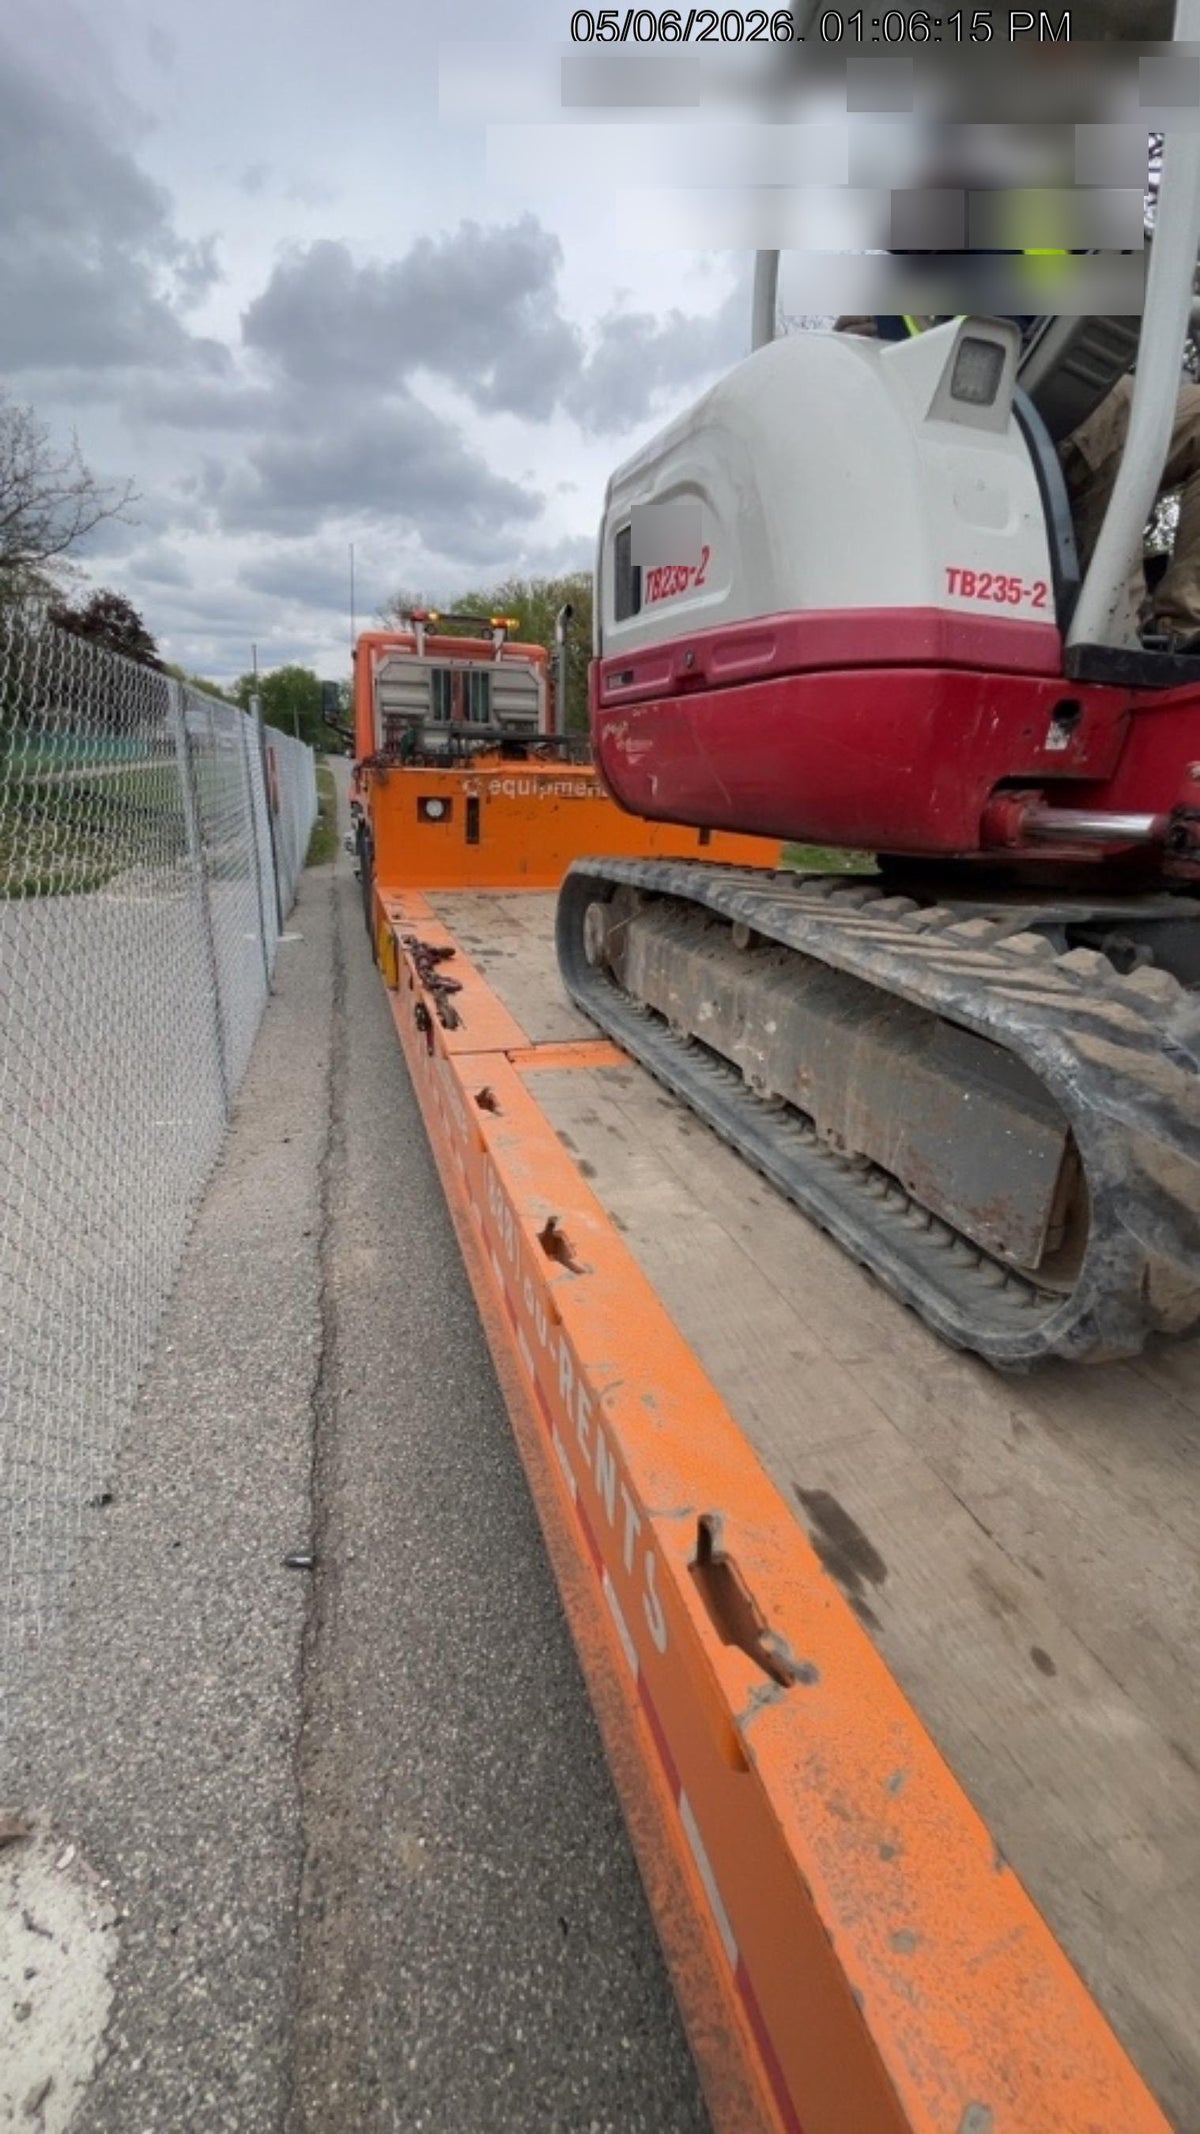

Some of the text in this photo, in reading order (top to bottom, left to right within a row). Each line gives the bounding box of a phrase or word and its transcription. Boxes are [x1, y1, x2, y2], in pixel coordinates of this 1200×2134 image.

[645, 544, 710, 606] TB235-2
[945, 567, 1048, 609] TB235-2
[488, 778, 609, 800] equipmen
